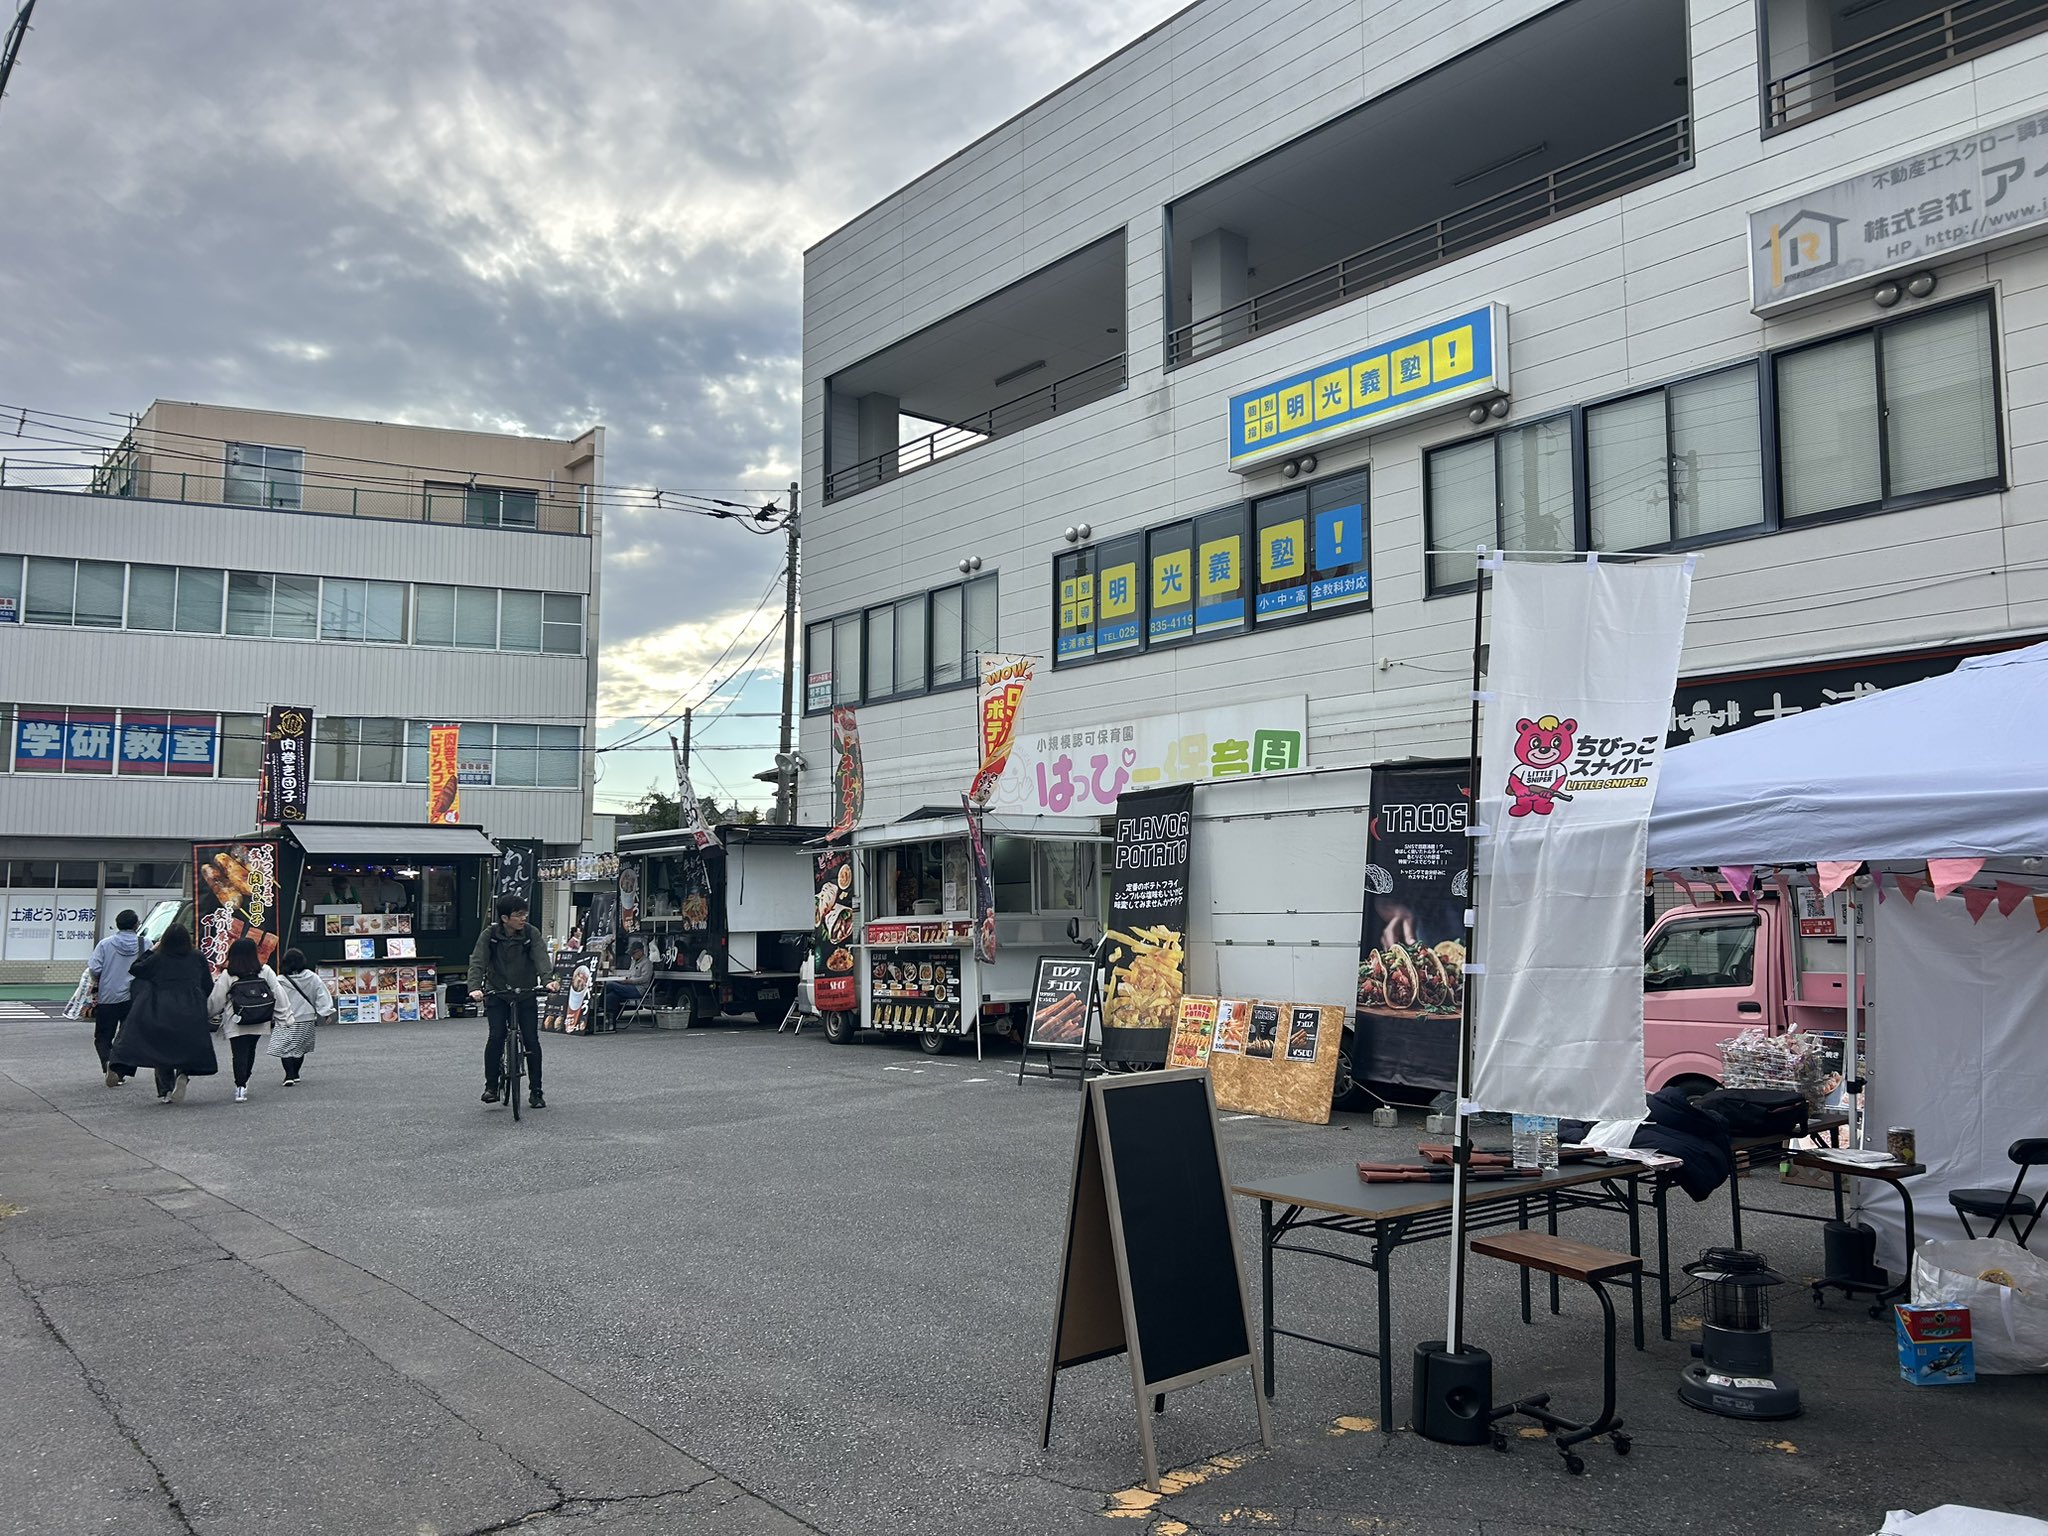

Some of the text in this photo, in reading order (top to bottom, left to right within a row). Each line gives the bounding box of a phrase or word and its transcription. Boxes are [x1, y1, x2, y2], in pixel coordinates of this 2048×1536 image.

[1863, 187, 1973, 244] 株式会社
[1886, 240, 1912, 260] HP
[1247, 396, 1274, 418] 個別
[1247, 419, 1274, 439] 指導
[1064, 581, 1091, 599] 個別
[1311, 574, 1368, 599] 全教科対応
[1064, 603, 1091, 624] 指導
[1060, 634, 1095, 652] 土浦教室
[985, 660, 1028, 686] WOW
[21, 722, 211, 763] 学研教室
[1036, 725, 1135, 753] 小規模認可保育園
[1575, 735, 1660, 758] ちびっこ
[280, 738, 298, 803] 肉巻き団子
[1526, 769, 1554, 778] LITTLE
[1569, 757, 1654, 778] スナイパー
[1526, 776, 1553, 784] SNIPER
[1565, 777, 1649, 792] LITTLE SNIPER
[1116, 811, 1190, 842] FLAVOR
[1381, 803, 1469, 833] TACOS
[1115, 839, 1188, 869] POTATO
[1125, 879, 1179, 892] 定番のポテトフライ
[1052, 966, 1081, 978] ロング
[1047, 979, 1082, 991] チュロス
[1184, 1003, 1212, 1014] FLAVOR
[1184, 1010, 1210, 1020] POTATO
[1254, 1010, 1277, 1020] TACOS
[1292, 1049, 1313, 1057] ¥500
